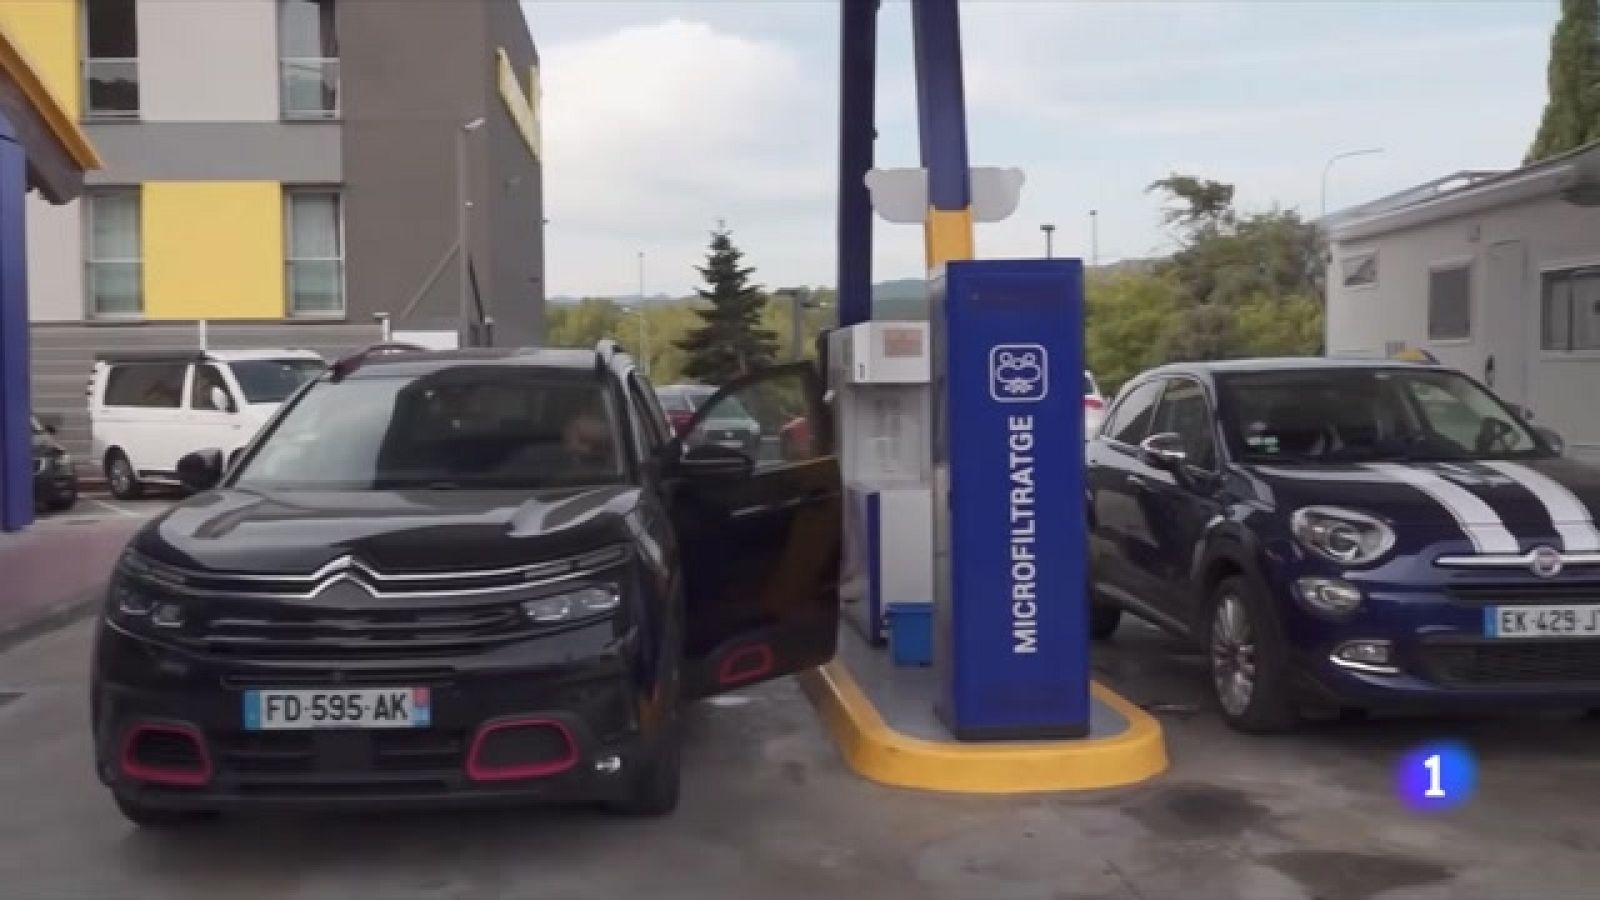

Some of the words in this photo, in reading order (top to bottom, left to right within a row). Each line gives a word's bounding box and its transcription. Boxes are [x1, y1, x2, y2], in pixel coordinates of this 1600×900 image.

[1009, 414, 1038, 654] MICROFILTRATGE
[1502, 609, 1600, 632] EK-429-J
[266, 694, 409, 721] FD-595-AK
